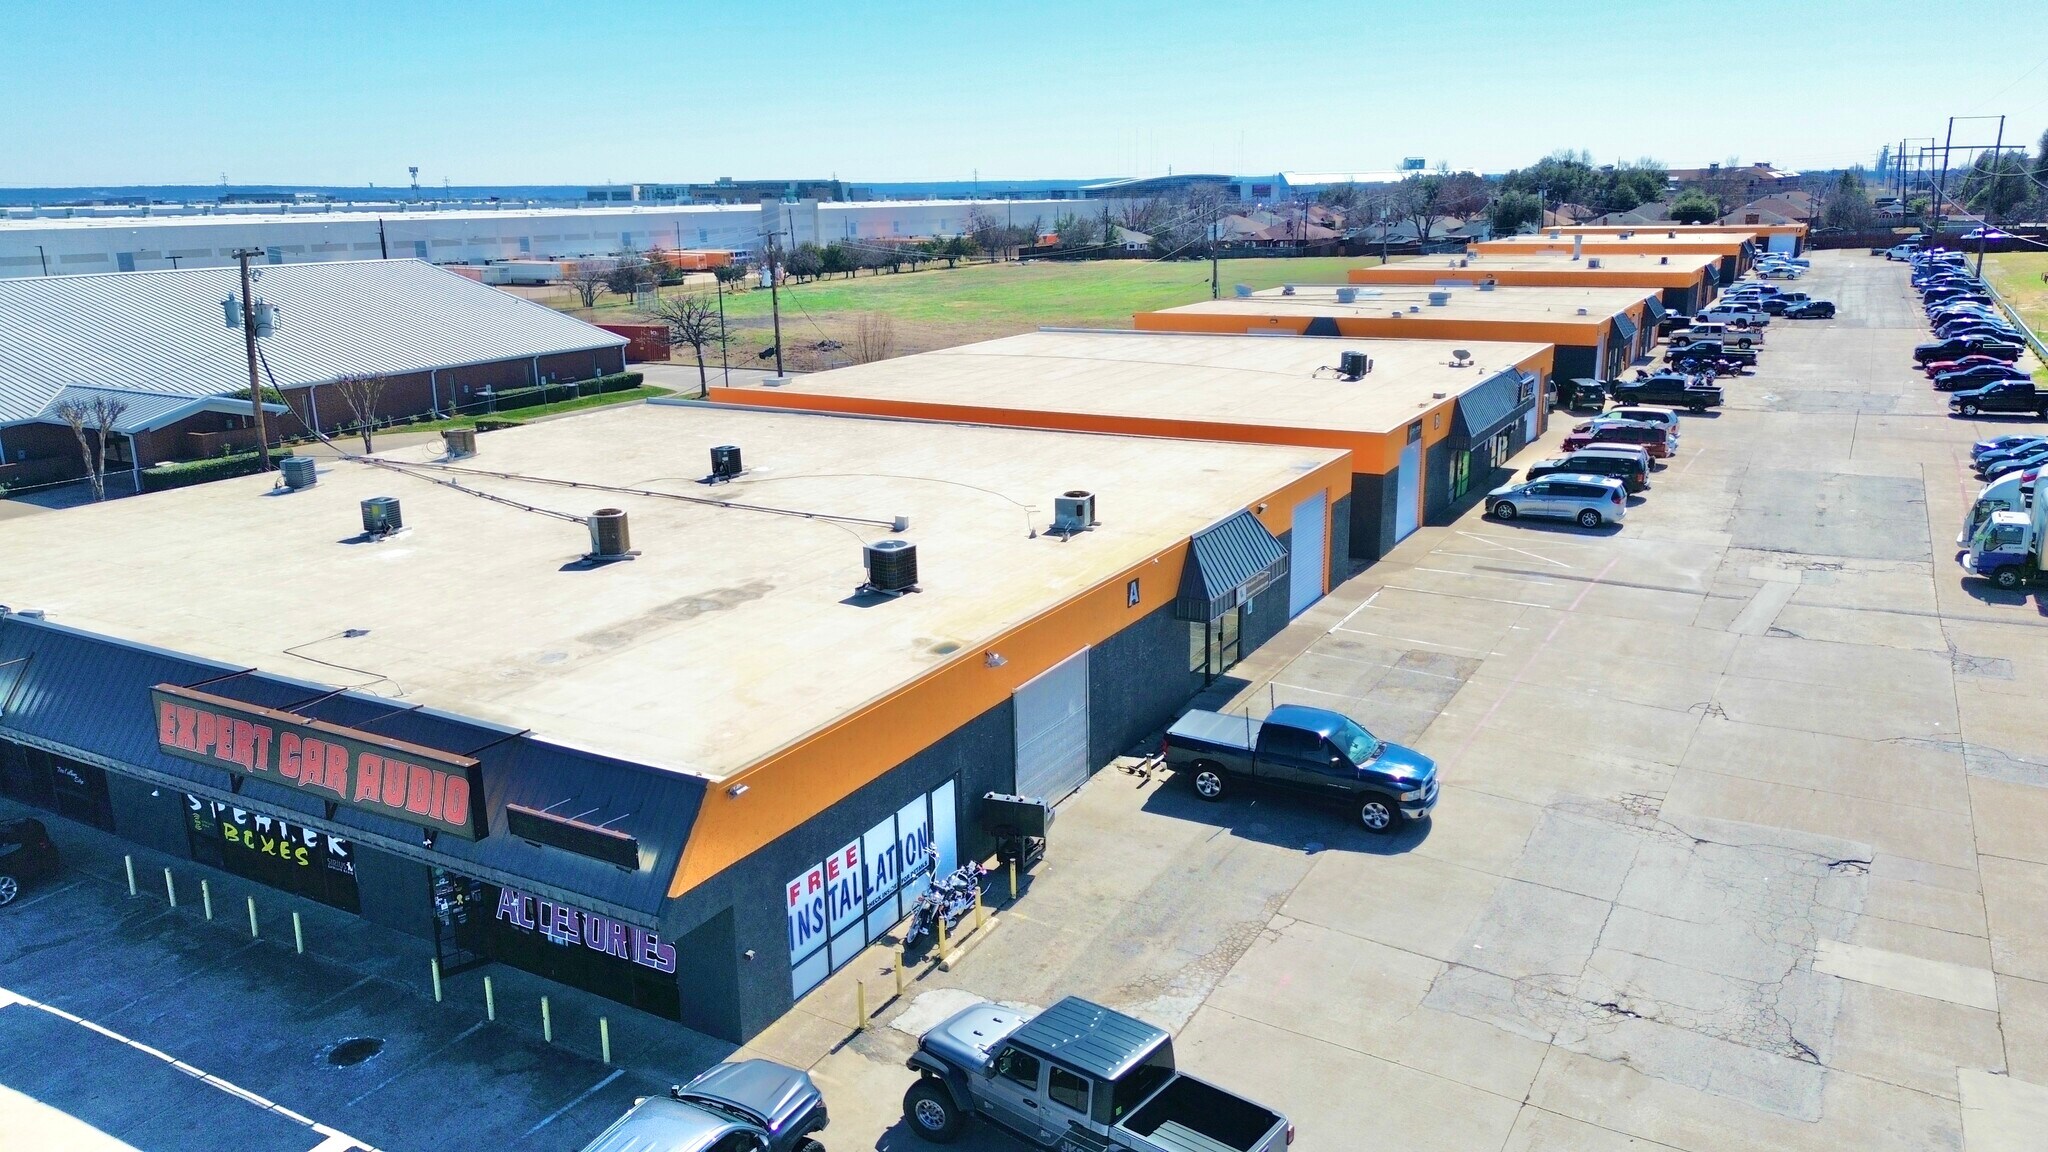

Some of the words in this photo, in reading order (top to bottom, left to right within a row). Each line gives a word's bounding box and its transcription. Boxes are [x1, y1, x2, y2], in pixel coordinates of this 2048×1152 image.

[1129, 580, 1140, 607] A
[159, 701, 272, 772] EXPERT
[279, 731, 350, 799] CAR
[354, 751, 470, 826] AUDIO
[223, 822, 309, 866] BOXES
[788, 822, 928, 951] INSTALLATION
[789, 845, 858, 907] FREE
